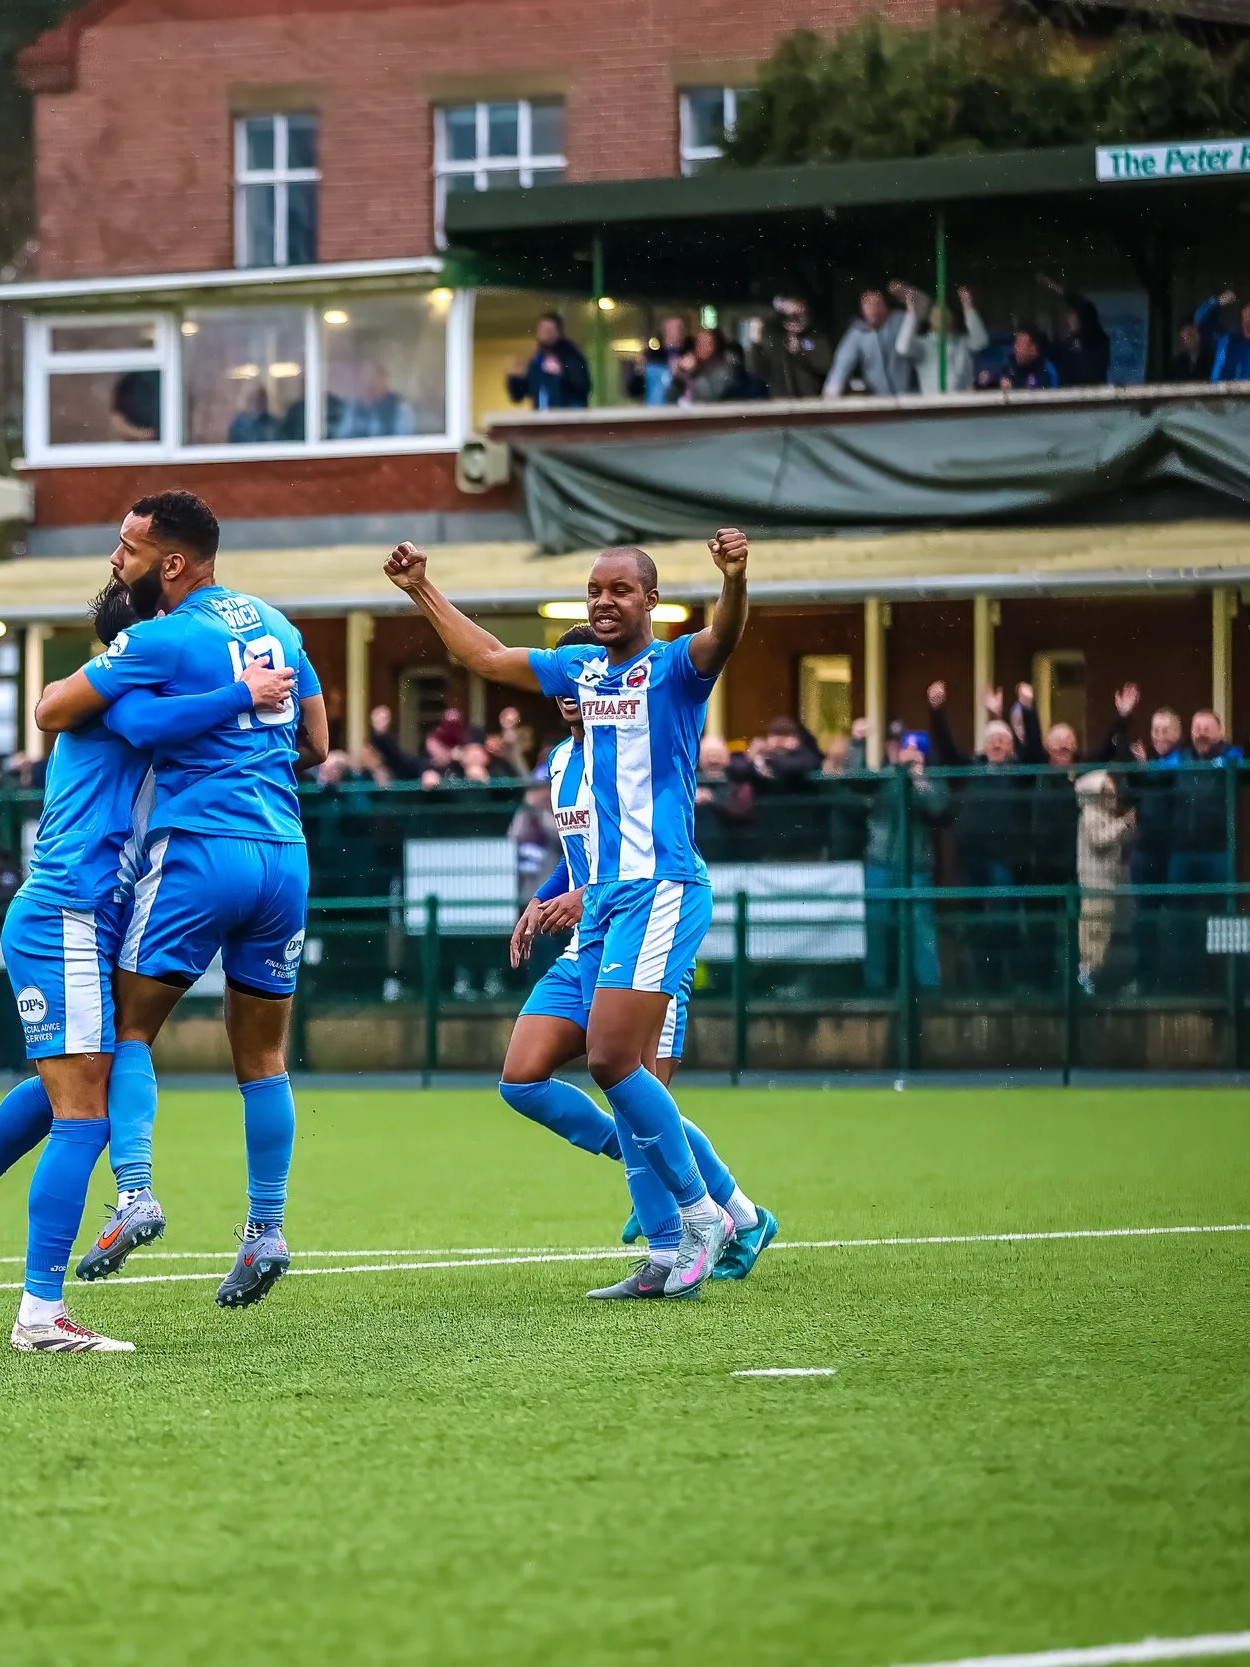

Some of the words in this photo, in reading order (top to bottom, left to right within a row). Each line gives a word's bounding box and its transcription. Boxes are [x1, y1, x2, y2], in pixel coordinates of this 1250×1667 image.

[1109, 151, 1157, 178] The
[1166, 145, 1234, 175] Peter
[19, 999, 45, 1012] DP's
[41, 1022, 61, 1032] ADVICE
[26, 1033, 53, 1043] SERVICES
